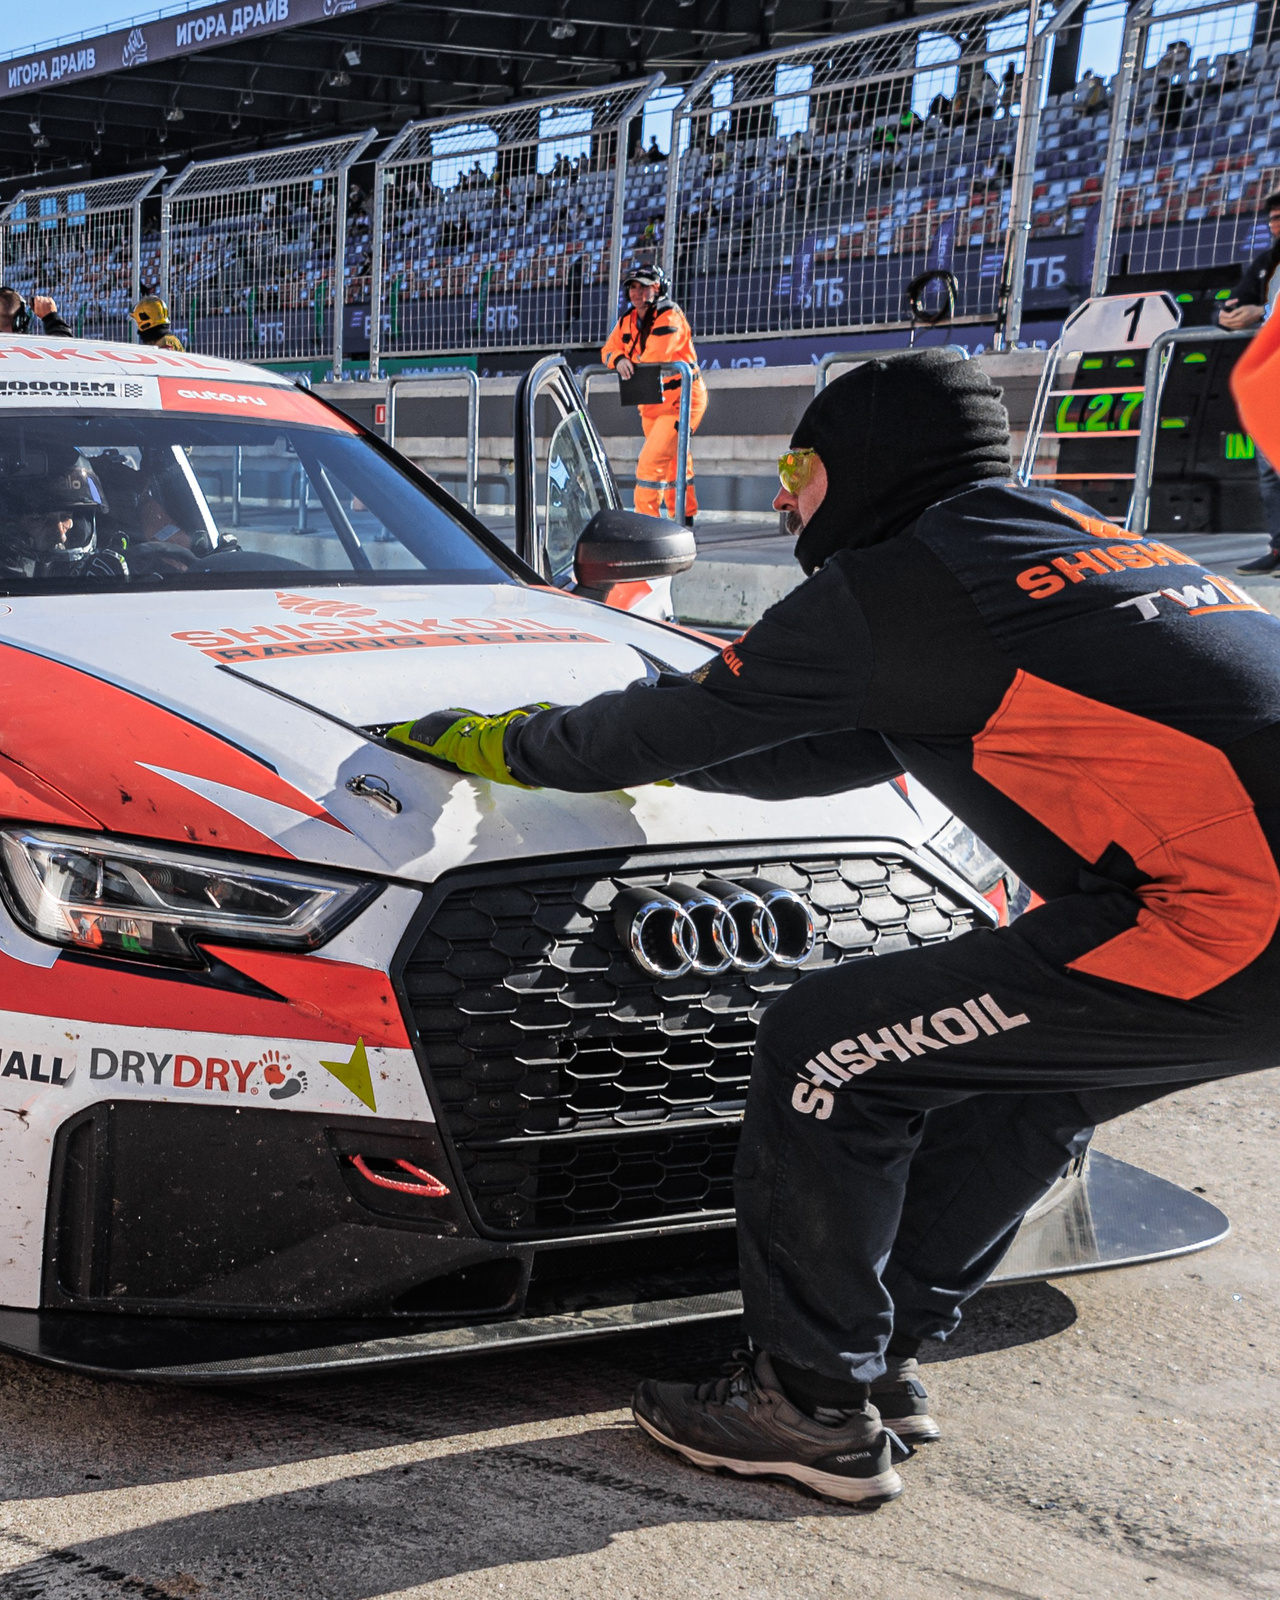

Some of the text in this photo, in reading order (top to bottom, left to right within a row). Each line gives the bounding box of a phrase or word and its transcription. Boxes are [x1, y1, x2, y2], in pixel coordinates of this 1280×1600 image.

[176, 13, 227, 47] ИГОРА
[7, 60, 48, 88] ИГОРА
[1026, 255, 1067, 290] ТБ
[486, 305, 518, 333] ВТБ
[1124, 297, 1146, 342] 1
[177, 388, 268, 407] auto.ru
[170, 616, 583, 648] SHISHKOIL
[218, 631, 593, 660] RACING TEAM
[791, 992, 1031, 1121] SHISHKOIL
